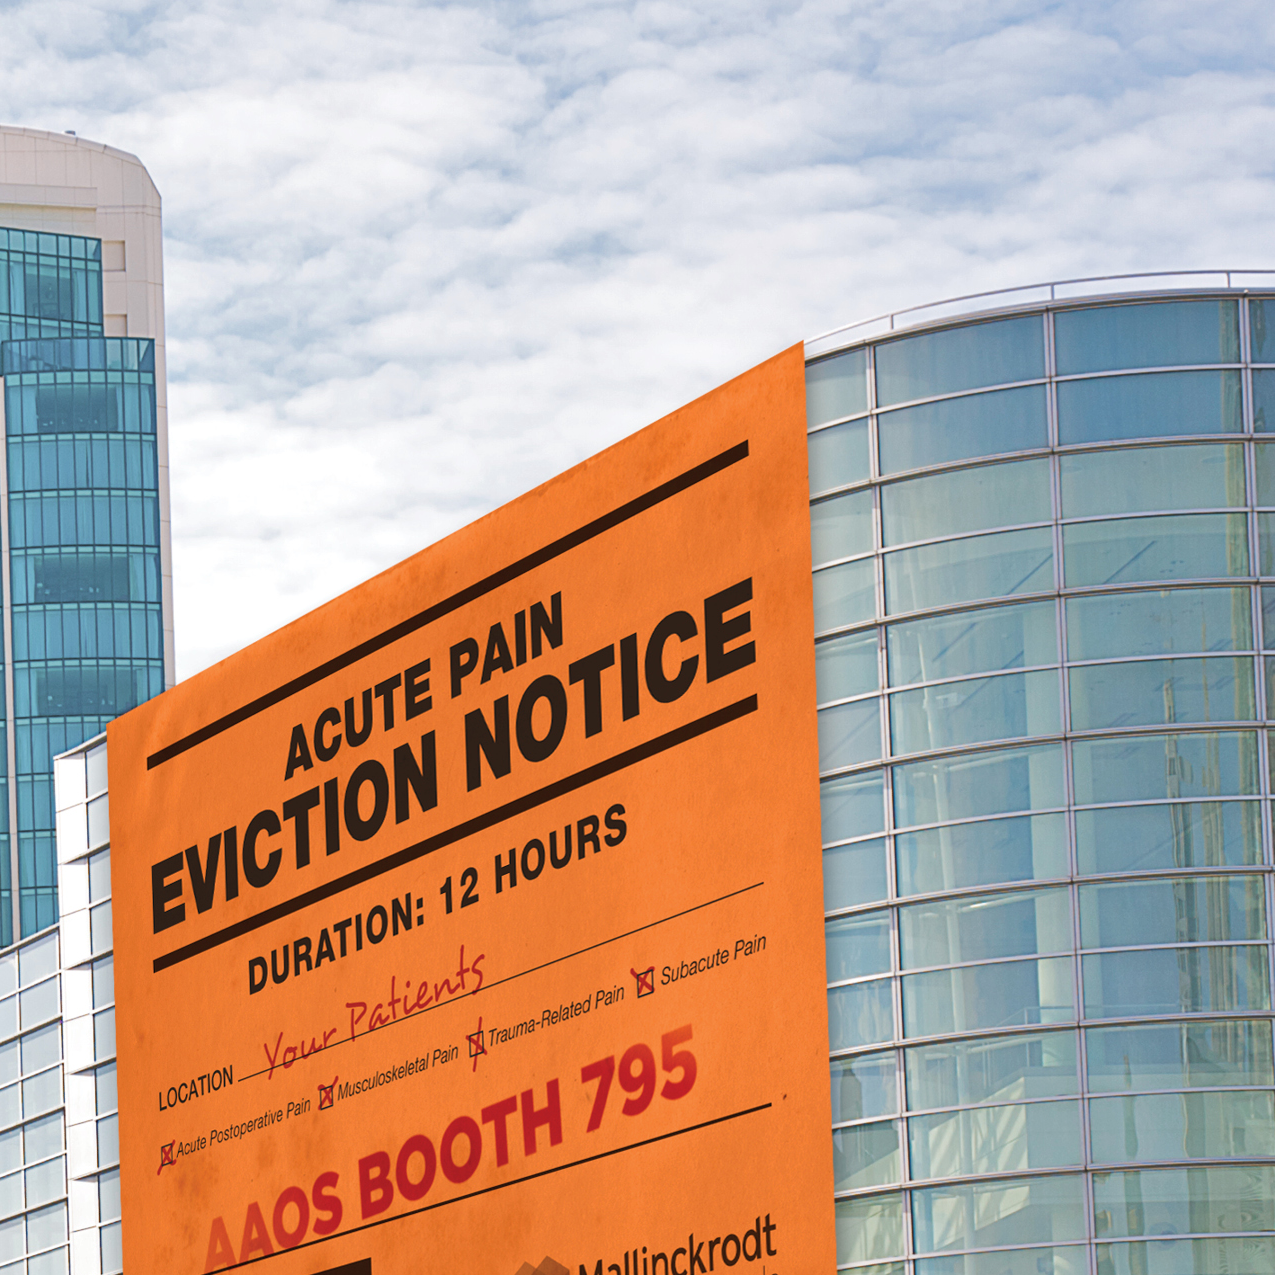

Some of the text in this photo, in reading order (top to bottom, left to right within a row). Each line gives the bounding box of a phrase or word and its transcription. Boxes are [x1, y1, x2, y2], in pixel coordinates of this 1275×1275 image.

[151, 576, 757, 935] EVICTION NOTICE
[284, 591, 564, 781] ACUTE PAIN
[248, 803, 627, 994] DURATION: 12 HOURS
[159, 1065, 233, 1111] LOCATION
[176, 934, 767, 1158] Acute Postoperative Pain Musculoskeletal Pain Trauma-Related Pain Subacute Pain
[264, 944, 486, 1080] Your Patients
[359, 1078, 564, 1219] BOOTH
[579, 1024, 699, 1133] 795
